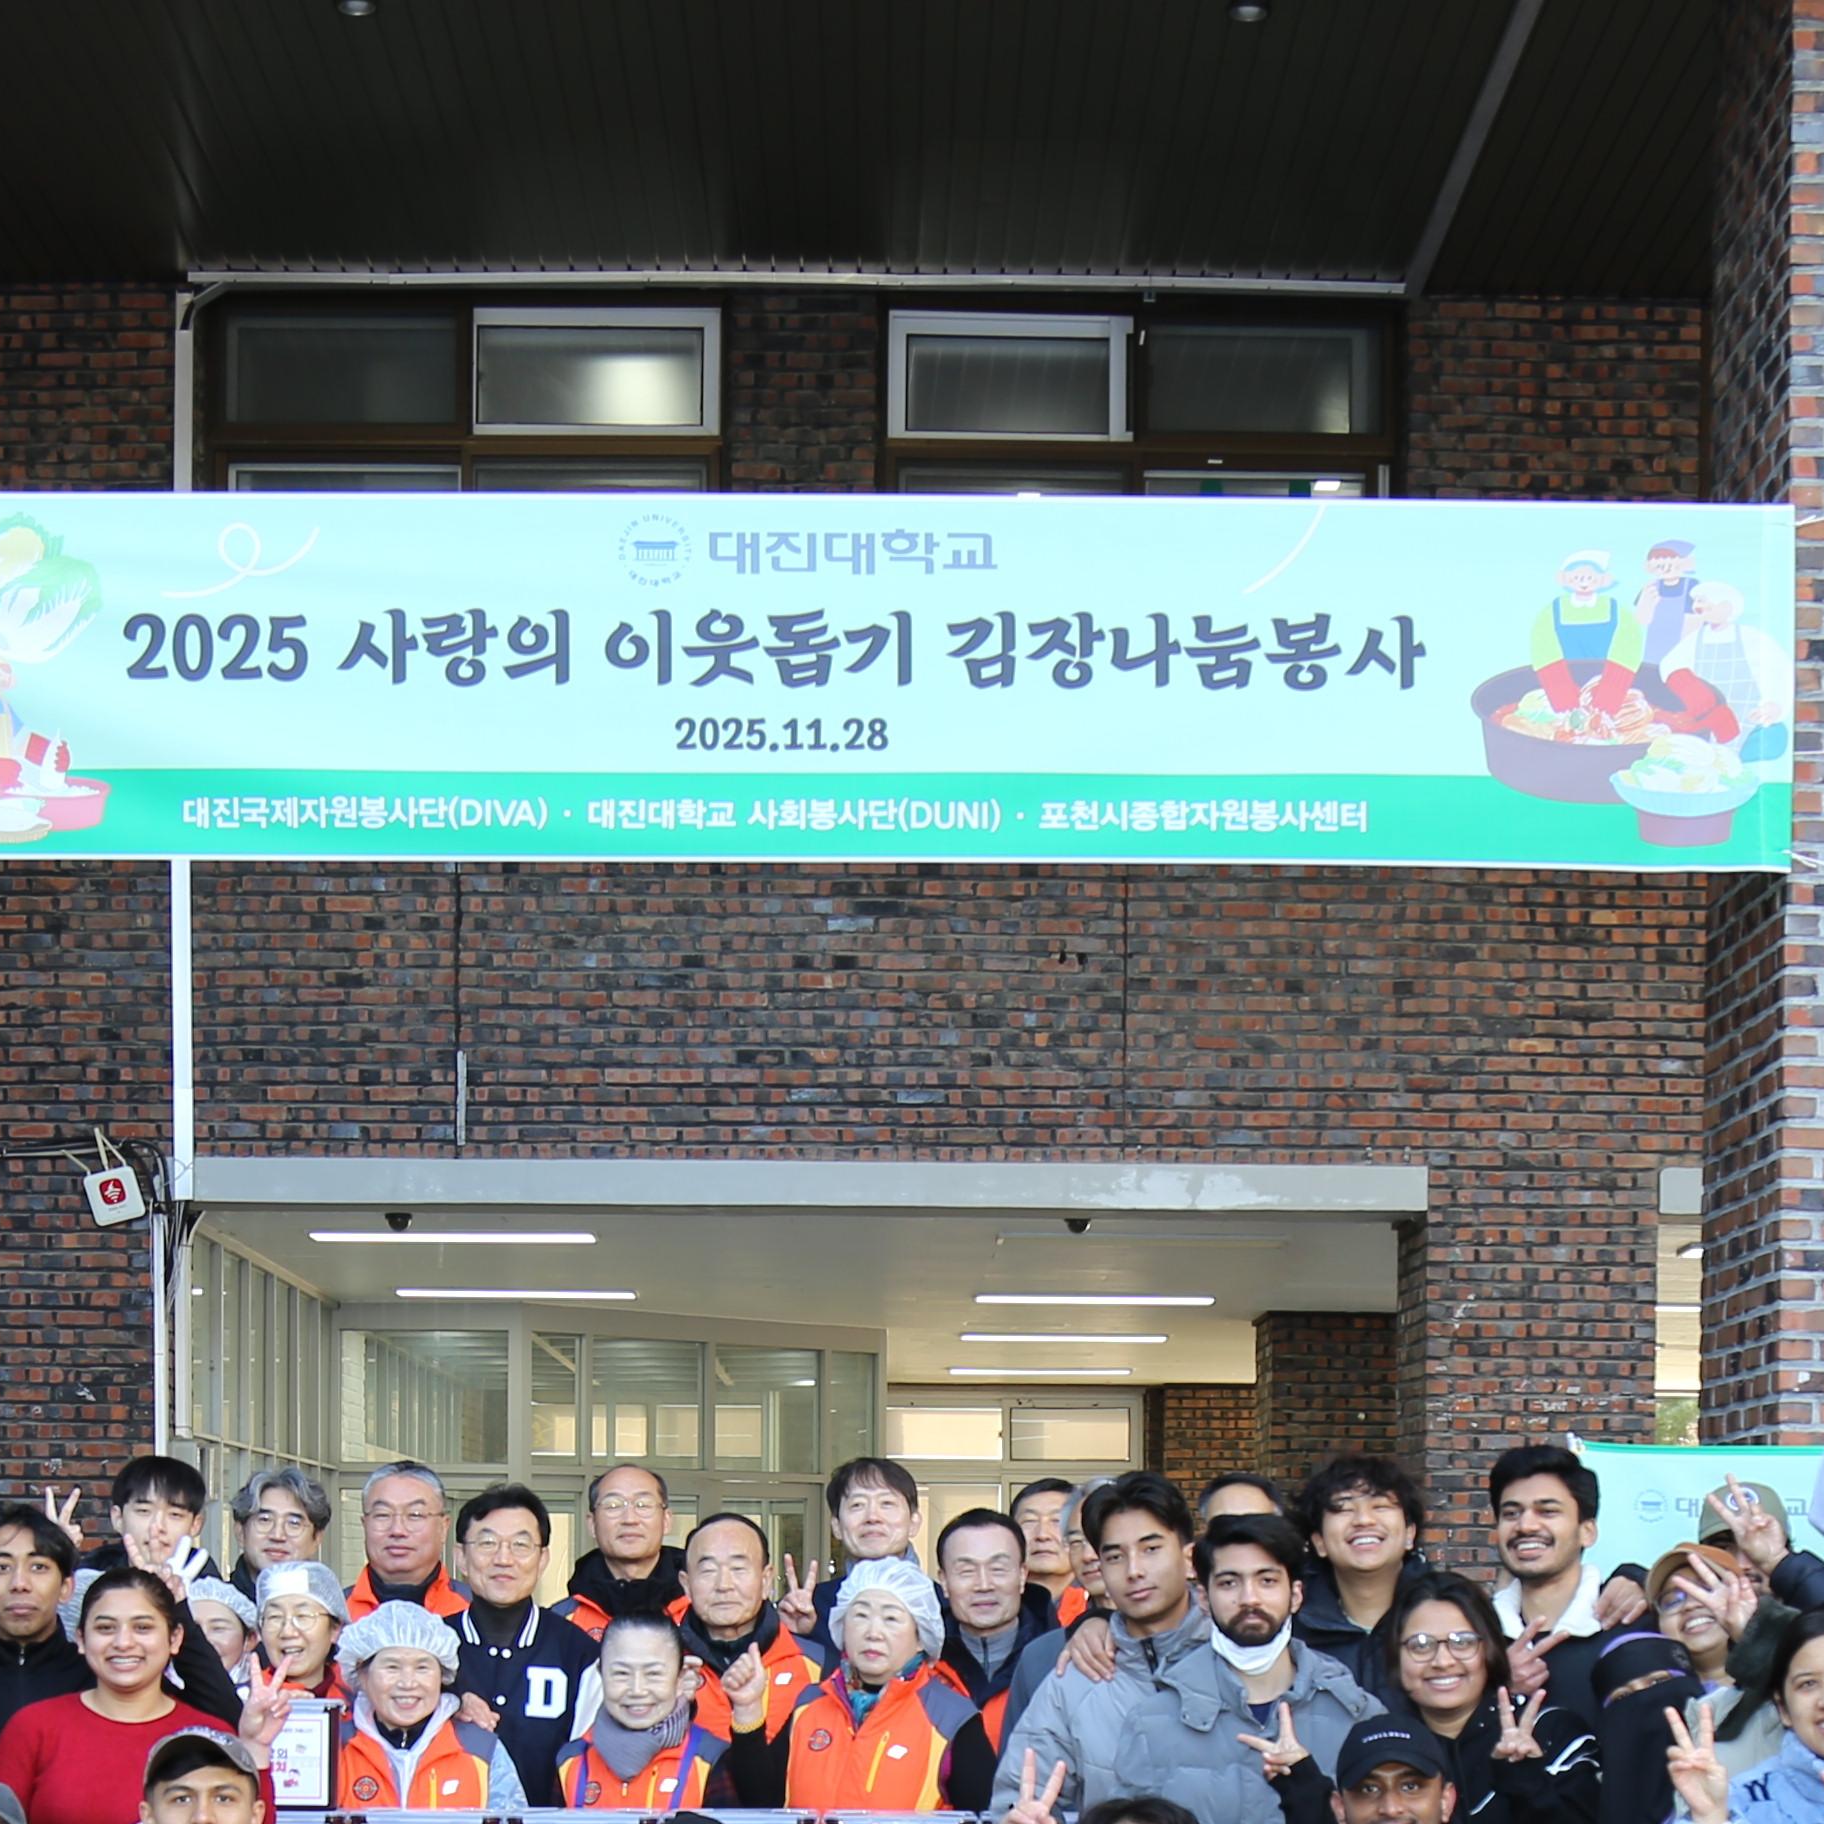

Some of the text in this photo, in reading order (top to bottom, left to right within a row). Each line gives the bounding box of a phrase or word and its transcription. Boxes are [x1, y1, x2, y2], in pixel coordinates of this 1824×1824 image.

[708, 528, 998, 575] 대진대학교
[122, 606, 1427, 692] 2025 사랑의 이웃돕기 김장나눔봉사
[674, 715, 890, 753] 2025.11.28
[182, 795, 1370, 835] 대진국제자원봉사단(DIVA) 대진대학교 사회봉사단(DUNI) 포천시종합자원봉사센터
[526, 1665, 568, 1719] D
